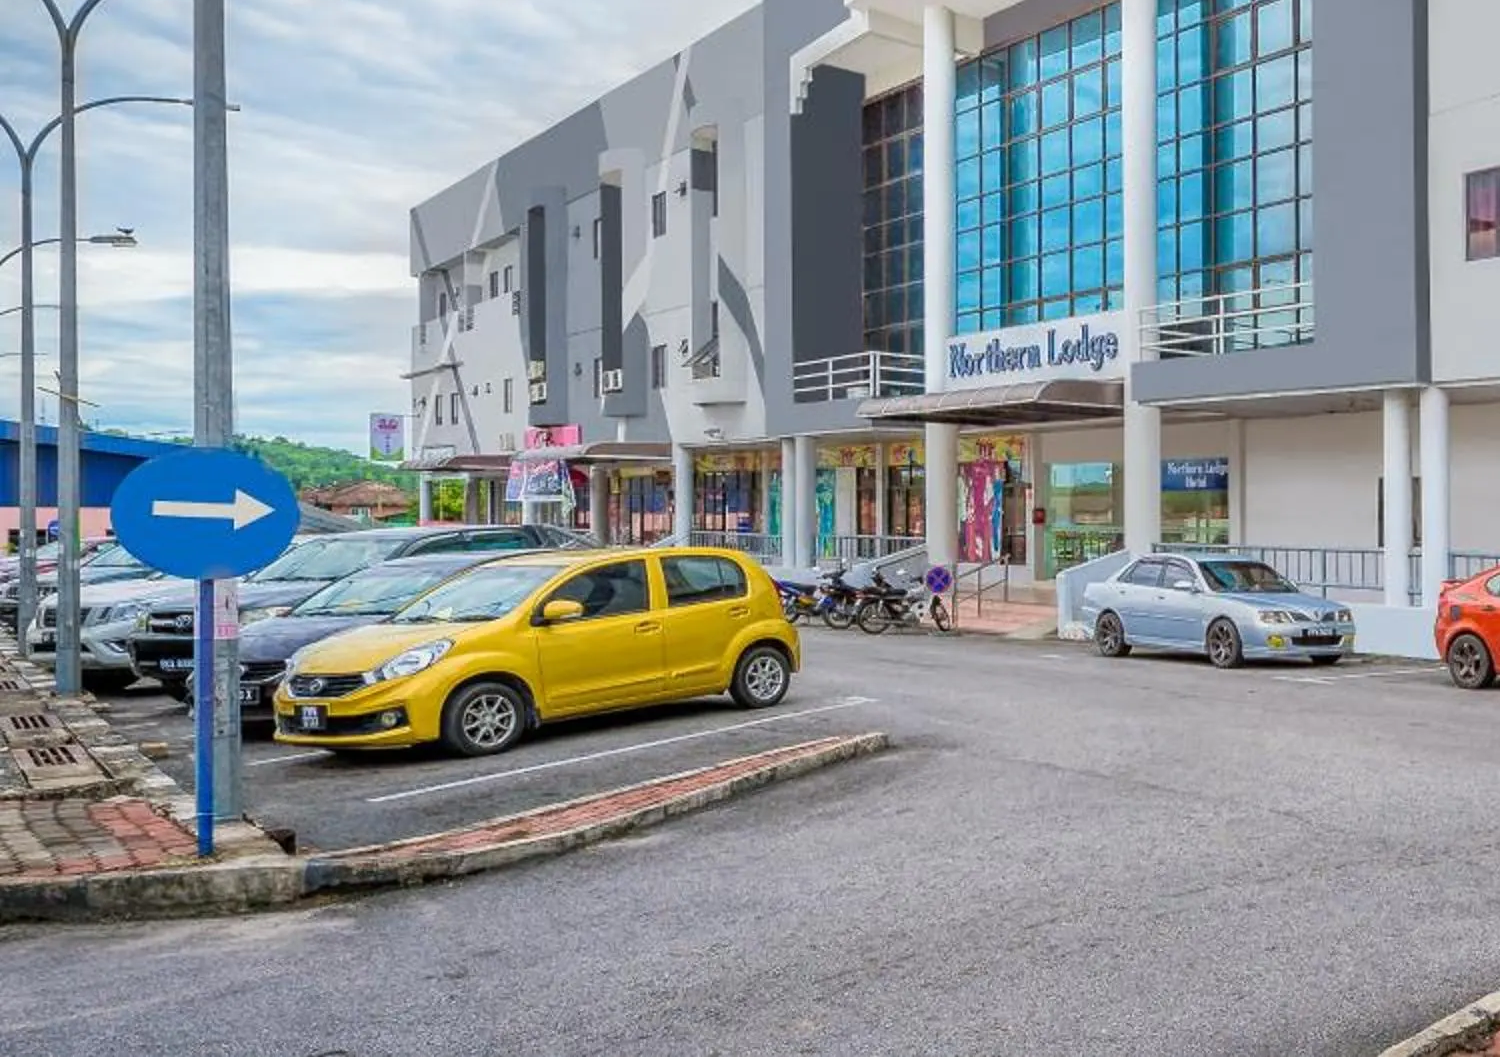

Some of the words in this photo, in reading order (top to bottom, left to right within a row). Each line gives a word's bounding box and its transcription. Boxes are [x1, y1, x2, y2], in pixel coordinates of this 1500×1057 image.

[948, 337, 1042, 378] Northern
[1047, 323, 1119, 372] Lodge
[1167, 462, 1203, 475] Northern
